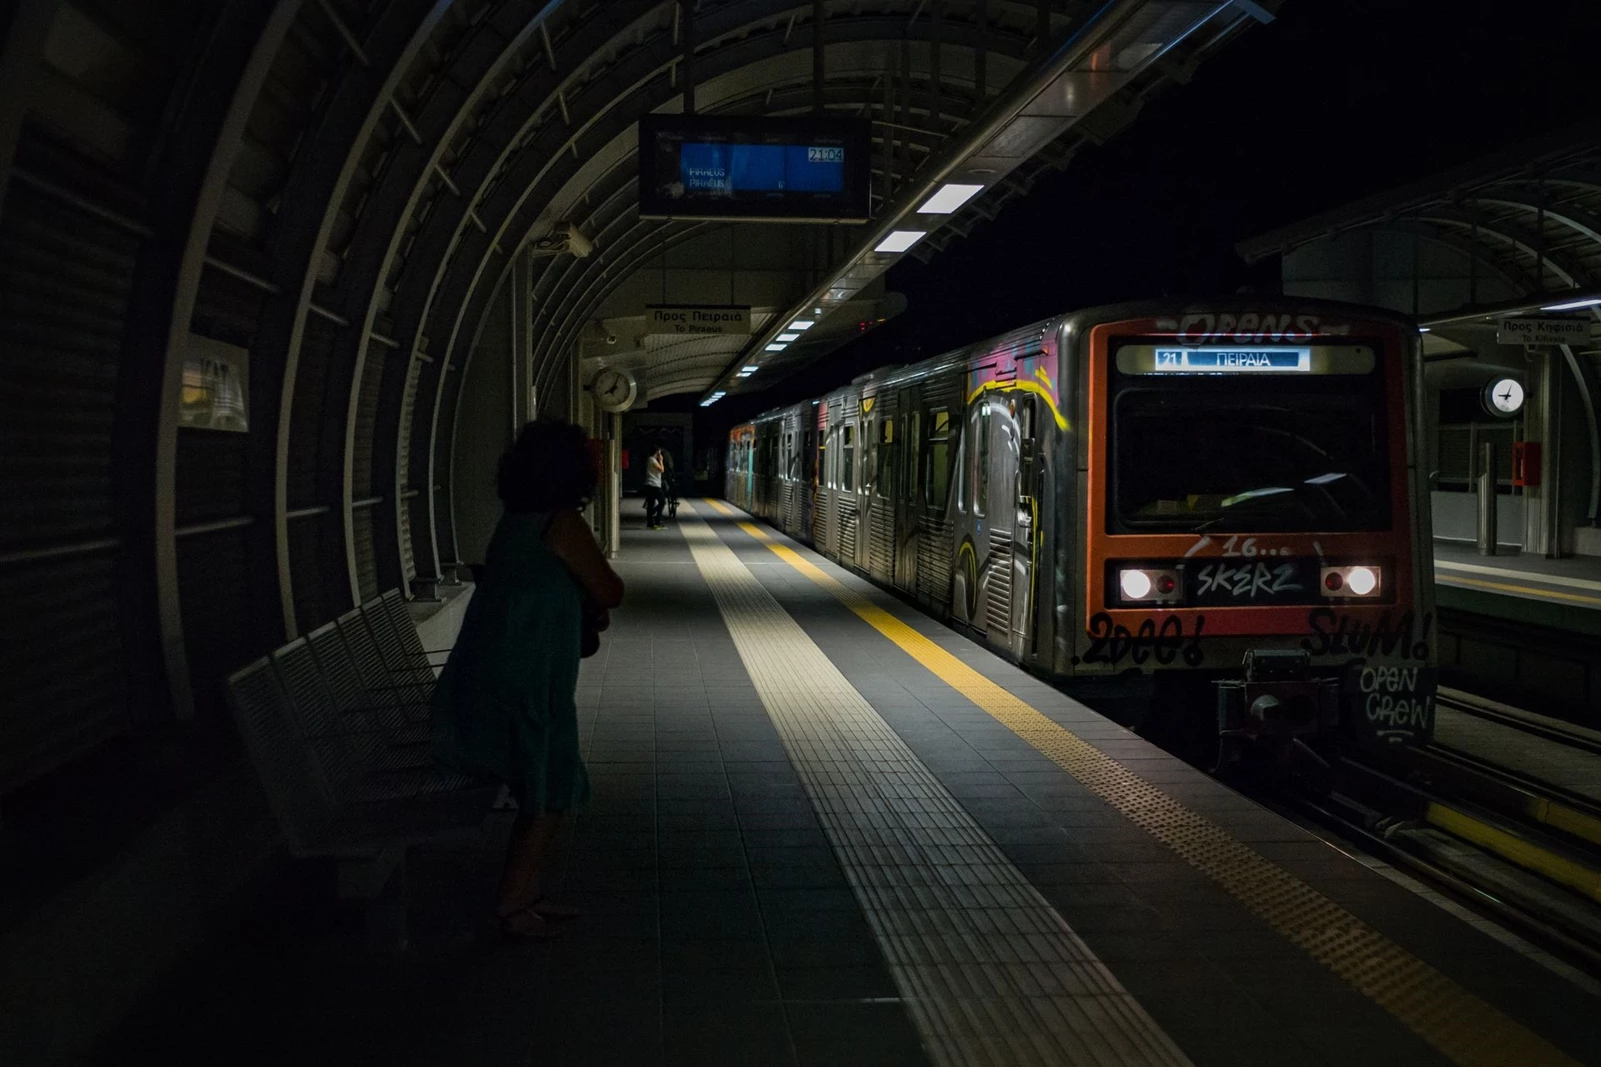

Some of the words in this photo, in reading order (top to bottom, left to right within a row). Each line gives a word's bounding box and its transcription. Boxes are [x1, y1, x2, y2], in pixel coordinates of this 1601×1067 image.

[810, 149, 842, 161] 21:04
[654, 310, 686, 323] Προς
[693, 311, 742, 323] Πειραιά
[675, 324, 685, 333] To
[689, 324, 722, 333] Piraeus
[1504, 321, 1532, 332] Προς
[1537, 322, 1583, 333] Κηφισιά
[1216, 352, 1271, 366] ΠΕΙΡΑΙΑ
